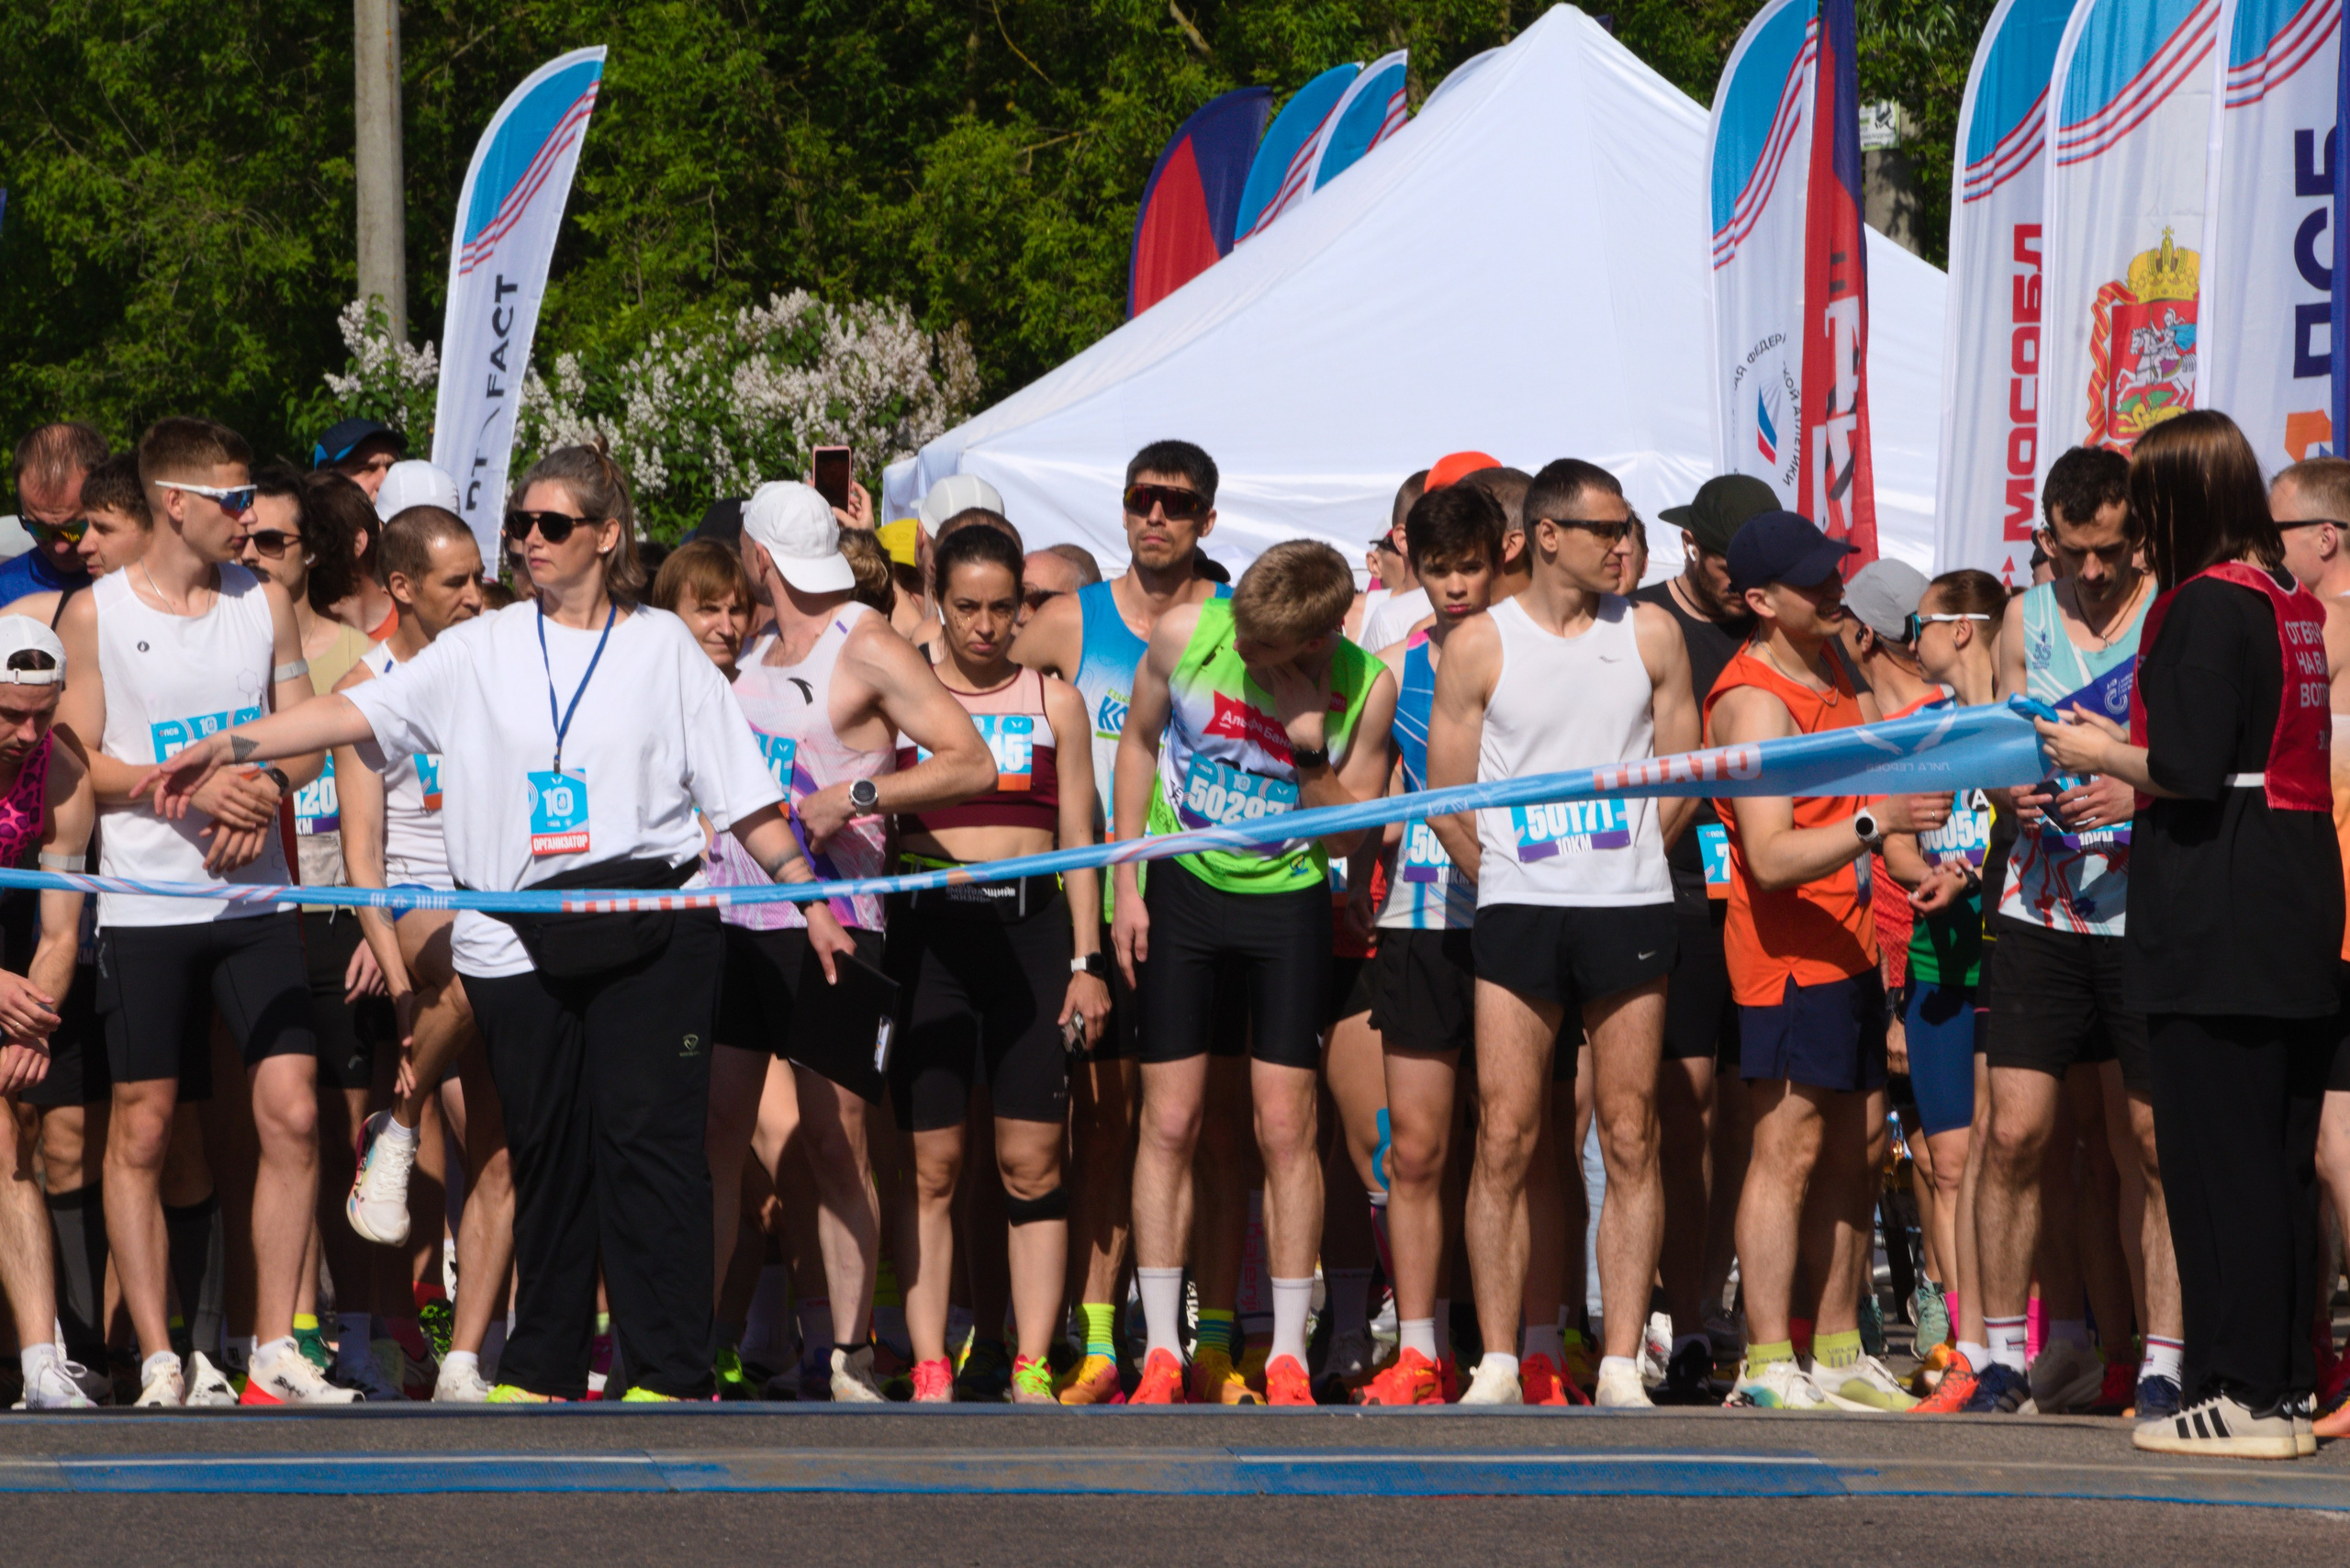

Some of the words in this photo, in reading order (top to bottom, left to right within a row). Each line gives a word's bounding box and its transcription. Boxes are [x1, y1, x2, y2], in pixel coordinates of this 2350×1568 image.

[2293, 128, 2336, 379] ПСБ
[487, 274, 518, 399] FACT
[1747, 332, 1786, 364] ФЕДЕР
[2003, 223, 2042, 543] МОСОБЛ
[2285, 621, 2324, 645] ОТВЕЧ
[2295, 651, 2316, 676] НА
[1219, 710, 1262, 733] Альфа
[542, 787, 574, 817] 10
[1525, 798, 1615, 842] 50171
[533, 834, 588, 852] ОРГАНИЗАТОР
